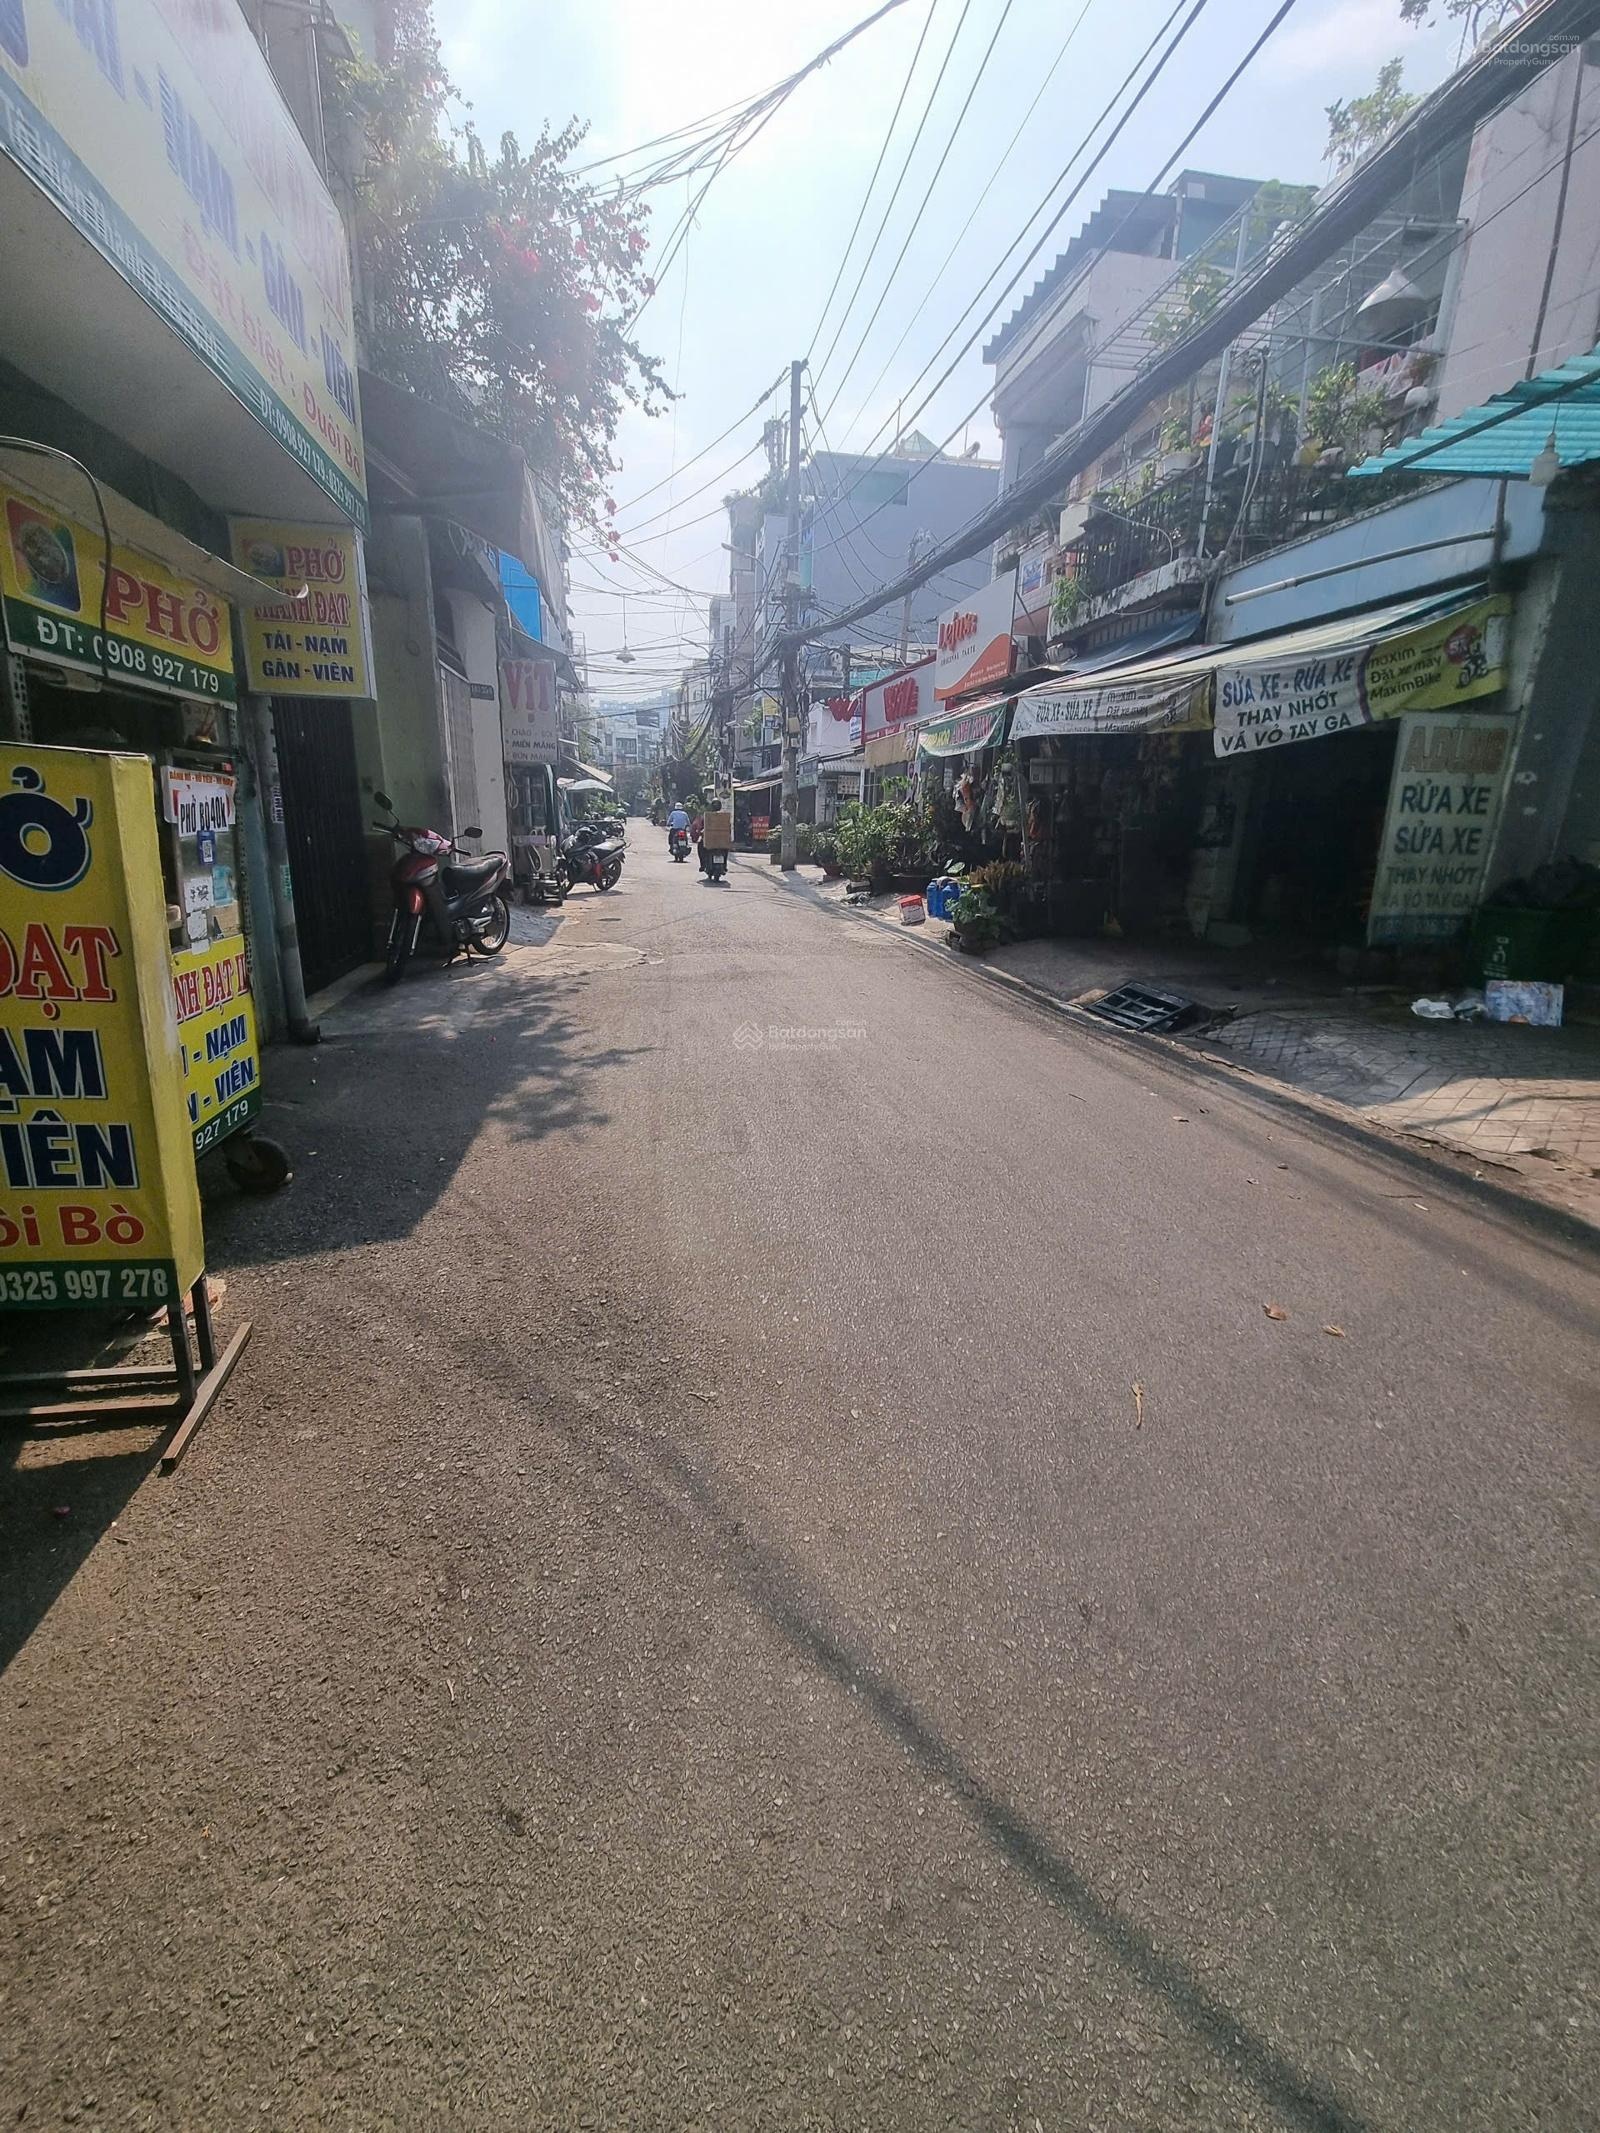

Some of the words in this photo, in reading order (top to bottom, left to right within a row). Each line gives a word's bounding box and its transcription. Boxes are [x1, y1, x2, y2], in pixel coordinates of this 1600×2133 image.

[284, 536, 346, 584] PHỞ
[99, 560, 220, 656] PHỞ
[37, 615, 84, 654] ĐT:
[152, 654, 184, 683] 927
[190, 667, 219, 694] 179
[312, 661, 354, 682] VIÊN
[1260, 672, 1281, 701] XE
[1331, 656, 1355, 685] XE
[1221, 730, 1247, 752] VÁ
[1289, 719, 1319, 740] TAY
[1324, 711, 1352, 732] GA
[1237, 704, 1283, 729] THAY
[1400, 778, 1452, 815] RỬA
[1457, 785, 1492, 816] XE
[1394, 819, 1445, 855] SỬA
[1450, 826, 1483, 856] XE
[202, 957, 234, 1016] ĐẠT
[206, 1013, 248, 1064] NẠM
[214, 1057, 256, 1105] VIÊN
[195, 1117, 221, 1151] 927
[225, 1099, 249, 1128] 179
[58, 1204, 145, 1247] Bò
[65, 1268, 111, 1299] 997
[121, 1268, 168, 1299] 278
